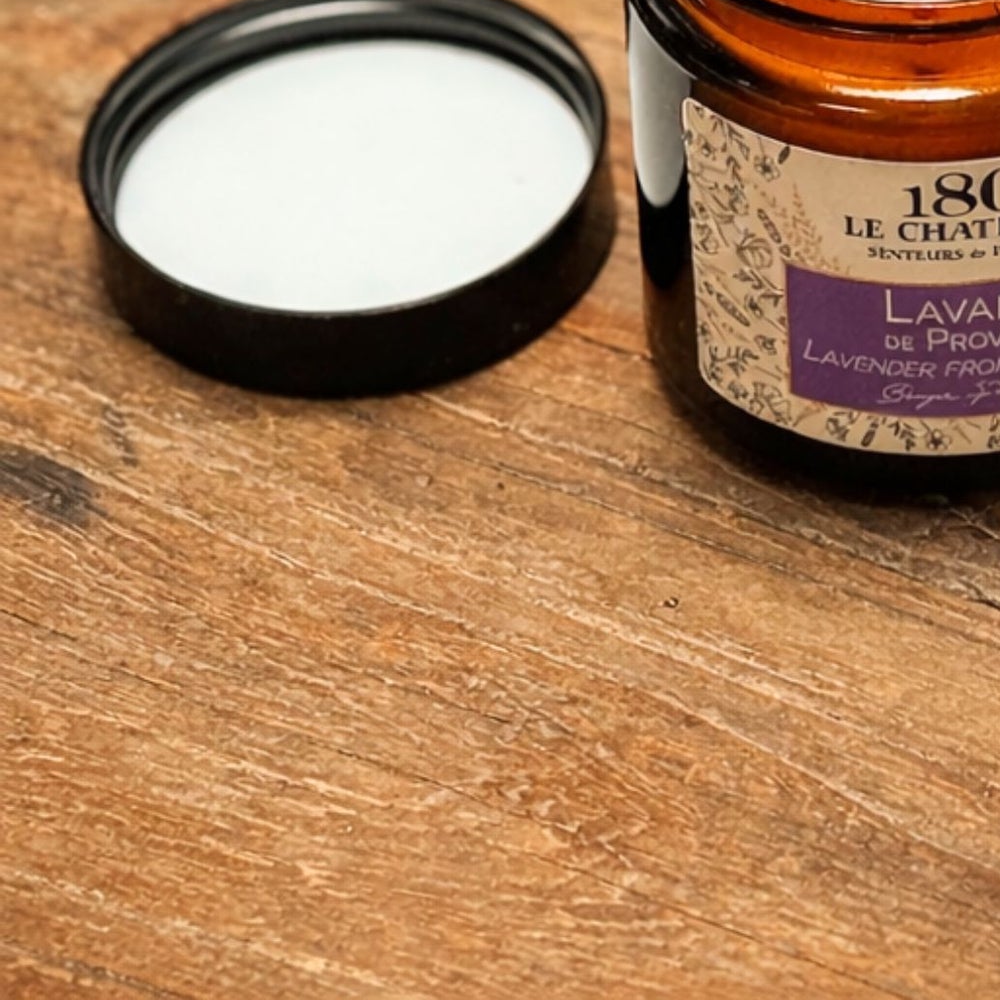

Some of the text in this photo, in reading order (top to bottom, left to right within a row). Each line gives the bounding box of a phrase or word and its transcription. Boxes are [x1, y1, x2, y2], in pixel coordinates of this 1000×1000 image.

[844, 215, 884, 239] LE
[867, 246, 964, 261] SENTEURS
[884, 335, 914, 351] DE
[802, 338, 937, 379] LAVENDER
